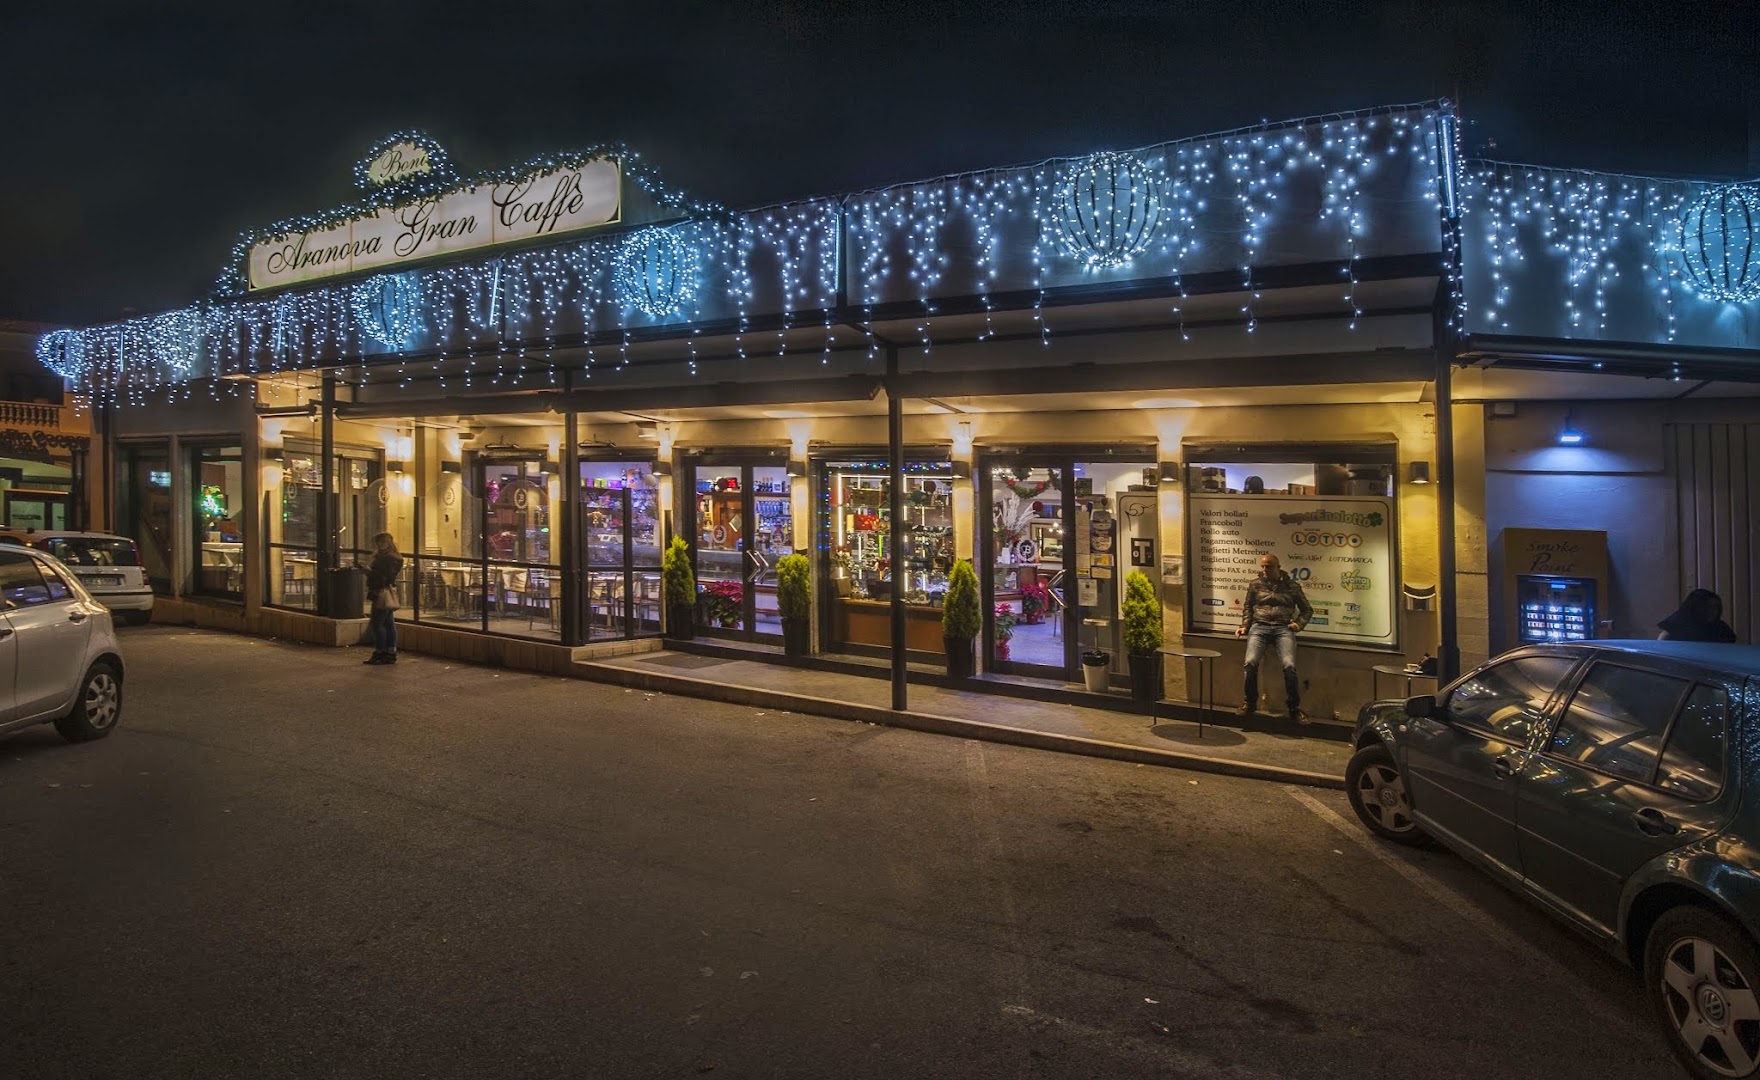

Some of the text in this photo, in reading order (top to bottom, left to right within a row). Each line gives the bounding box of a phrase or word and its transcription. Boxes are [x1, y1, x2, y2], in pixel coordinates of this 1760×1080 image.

[380, 150, 426, 178] Boni
[267, 172, 584, 274] Aranova Gran Caffè
[1200, 509, 1248, 518] Valori bollati
[1200, 519, 1243, 527] Francobolli
[1200, 527, 1220, 535] Bollo
[1201, 537, 1244, 546] Pagamento
[1201, 546, 1270, 556] Biglietti Metrebus
[1201, 555, 1257, 565] Biglietti Cotral
[1328, 556, 1373, 564] LOTTOMATICA
[1290, 567, 1311, 581] 10
[1202, 575, 1232, 583] Trasporto
